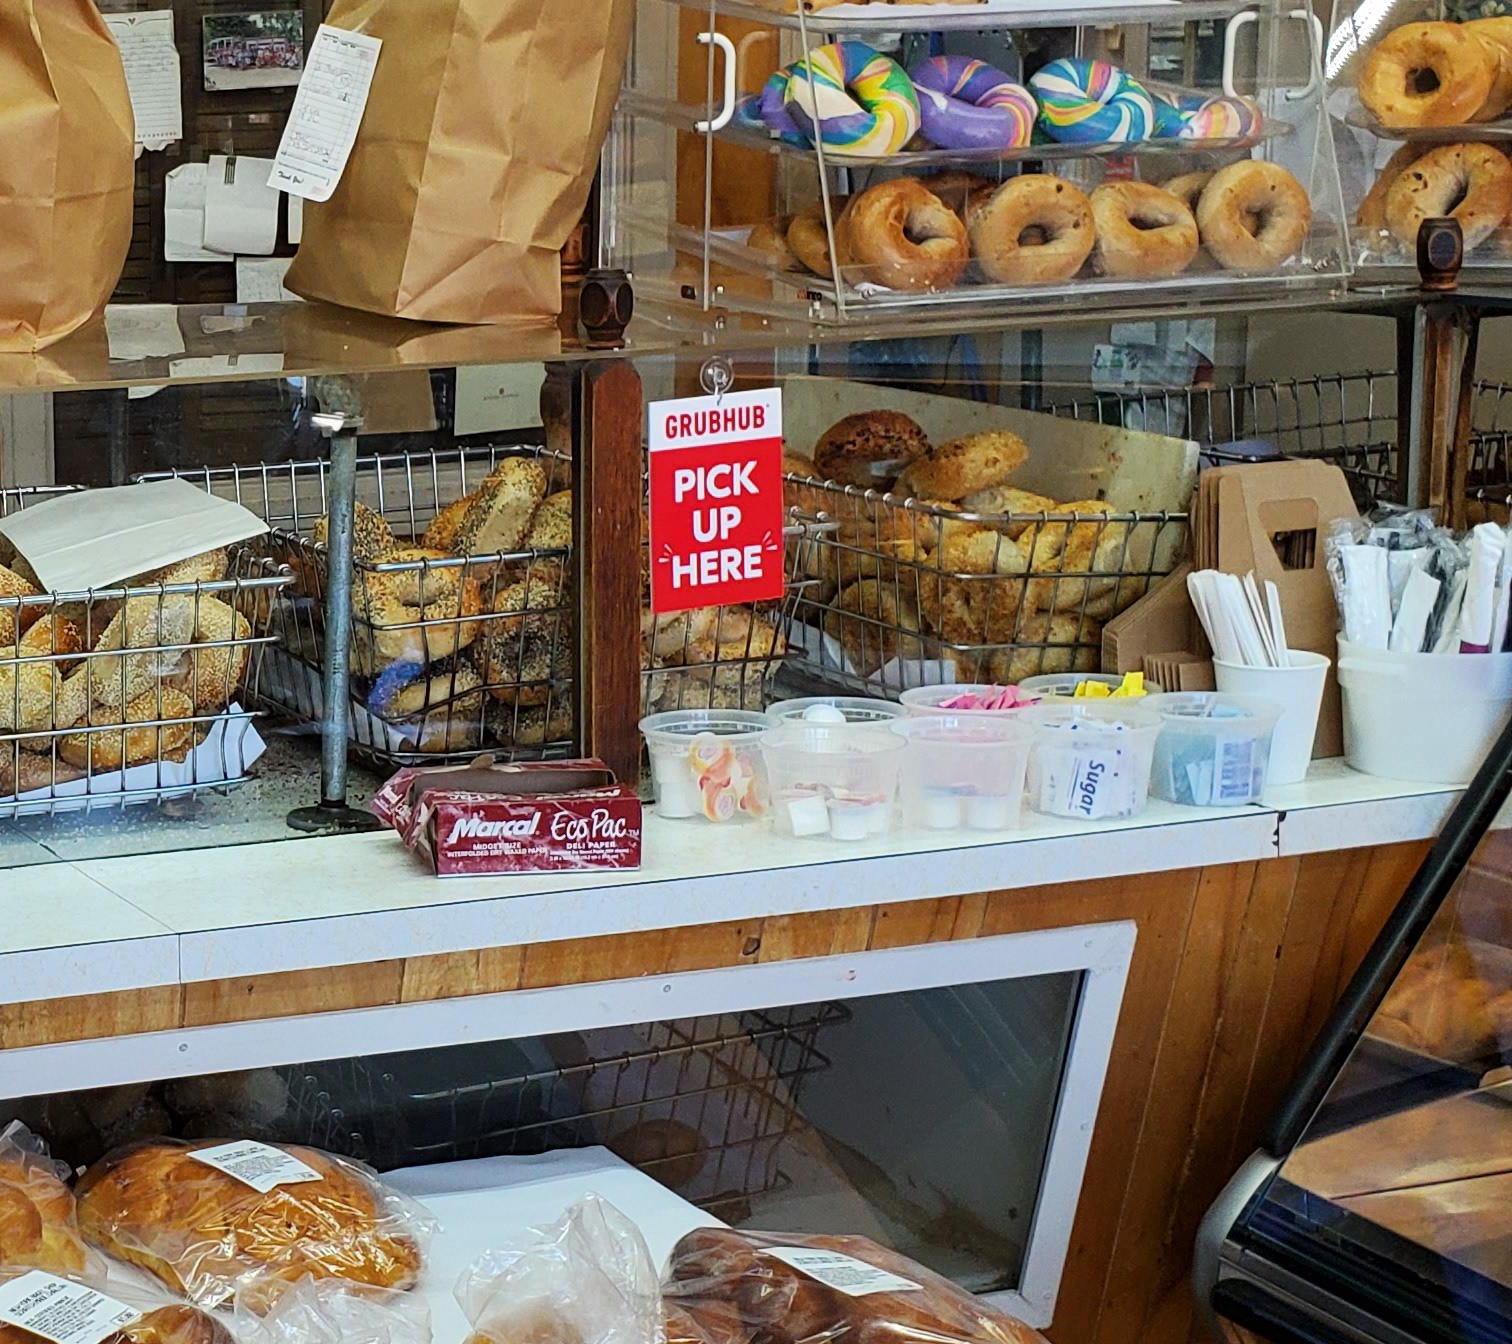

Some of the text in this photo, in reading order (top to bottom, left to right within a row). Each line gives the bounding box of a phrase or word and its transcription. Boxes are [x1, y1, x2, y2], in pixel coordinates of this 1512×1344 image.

[665, 404, 766, 440] GRUBHUB
[674, 460, 759, 503] PICK
[692, 507, 742, 543] UP
[671, 544, 764, 589] HERE
[1080, 760, 1105, 814] Sugar
[447, 812, 539, 844] Marcal
[566, 842, 586, 850] DELI
